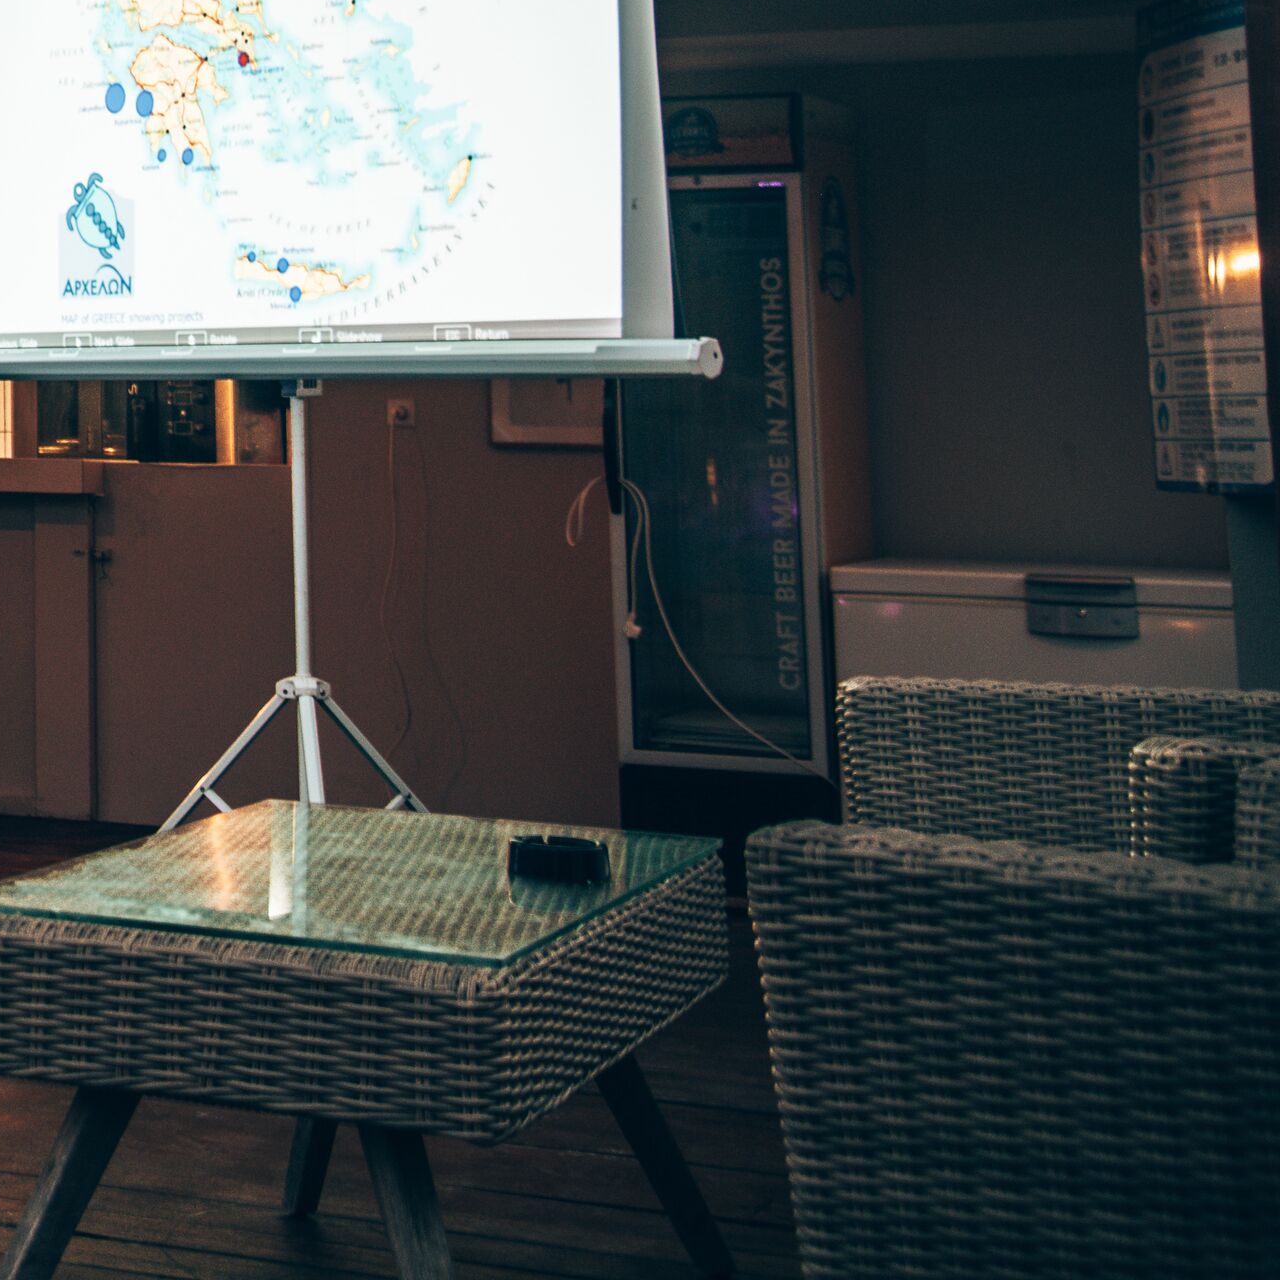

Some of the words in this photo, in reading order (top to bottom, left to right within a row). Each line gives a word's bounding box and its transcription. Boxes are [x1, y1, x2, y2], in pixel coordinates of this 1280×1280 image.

[80, 312, 90, 323] of
[90, 312, 126, 324] GREECE
[127, 312, 166, 325] showing
[167, 311, 205, 326] projects
[475, 327, 509, 340] Return
[759, 255, 787, 410] ZAKYNTHOS
[768, 418, 788, 441] IN
[768, 453, 794, 528] MADE
[773, 538, 797, 600] BEER
[777, 613, 802, 691] CRAFT
